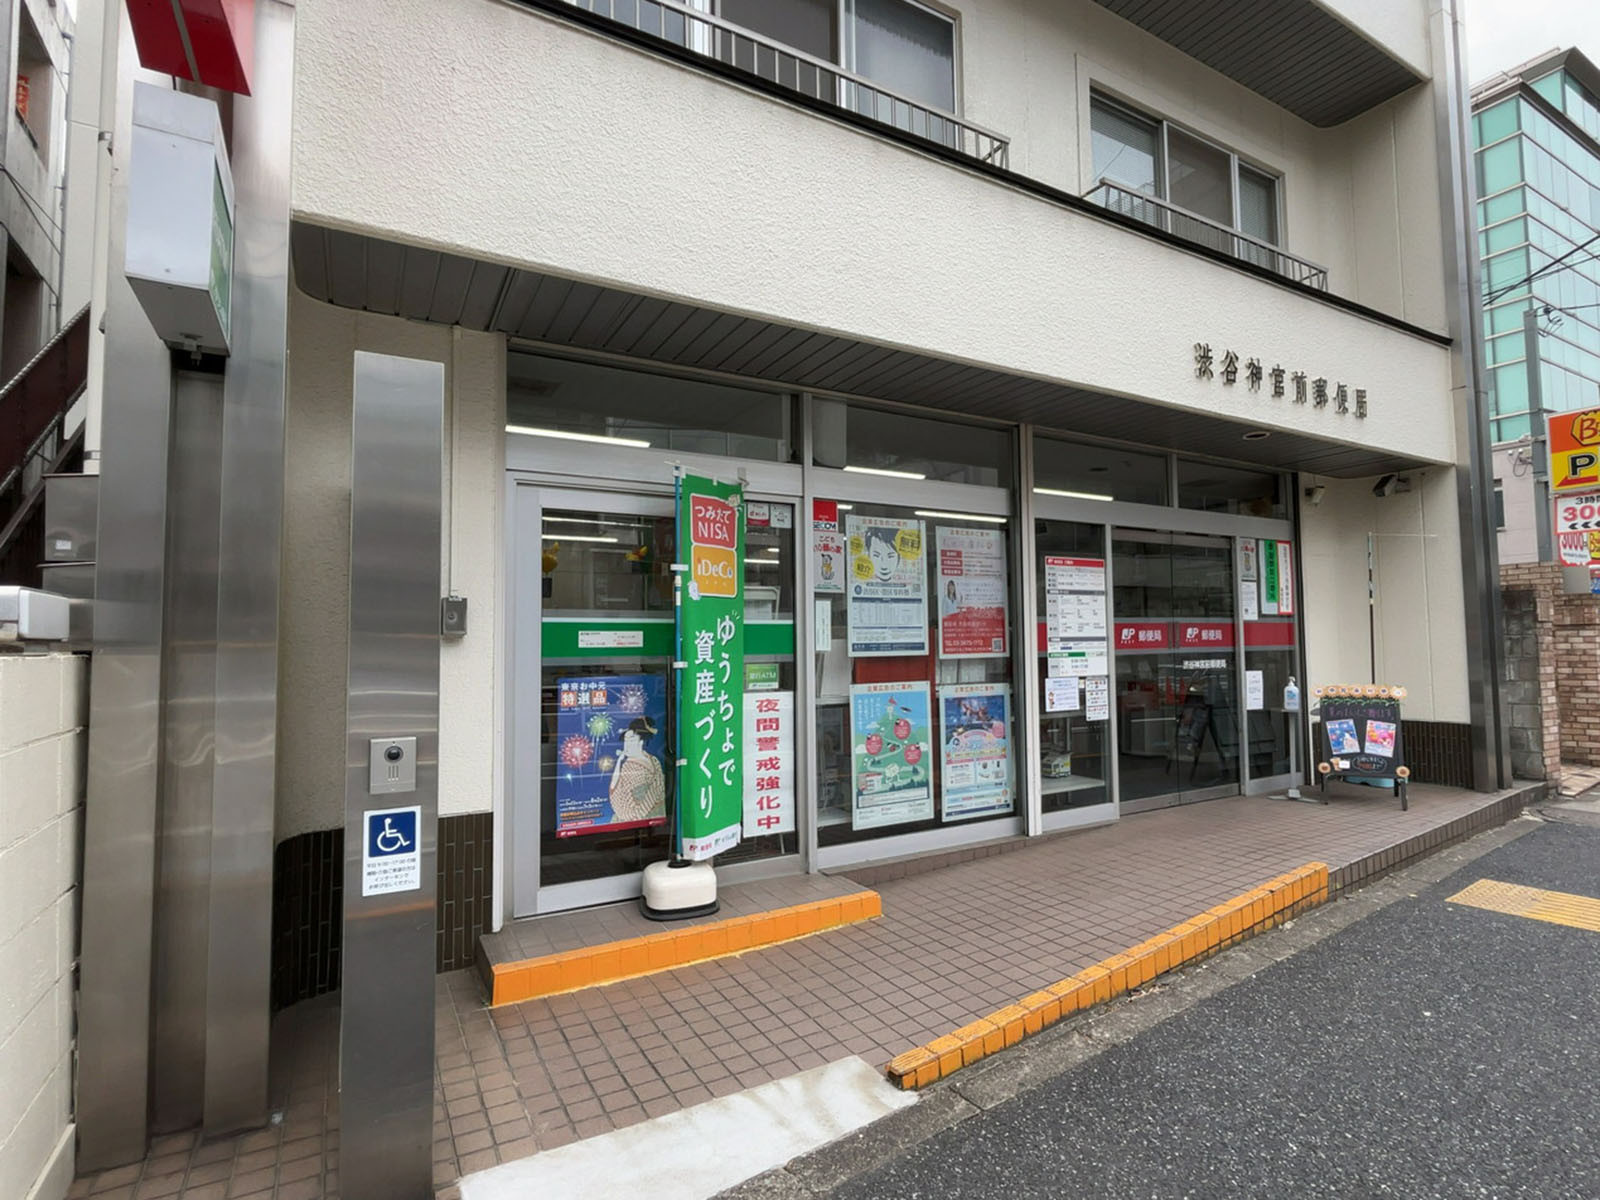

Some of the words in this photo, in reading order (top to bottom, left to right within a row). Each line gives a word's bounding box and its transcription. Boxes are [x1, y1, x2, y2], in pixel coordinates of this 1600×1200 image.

[1193, 343, 1368, 418] 渋谷神宮前郵便局
[1570, 455, 1597, 477] P
[695, 506, 732, 523] つみたて
[698, 521, 730, 543] NISA
[697, 559, 733, 578] iDeCo
[1138, 630, 1162, 641] 郵便局
[1201, 629, 1222, 640] 郵便局
[717, 613, 736, 787] ゆうちょで
[694, 630, 716, 819] 資産づくり
[755, 698, 781, 830] 夜間警戒強化中
